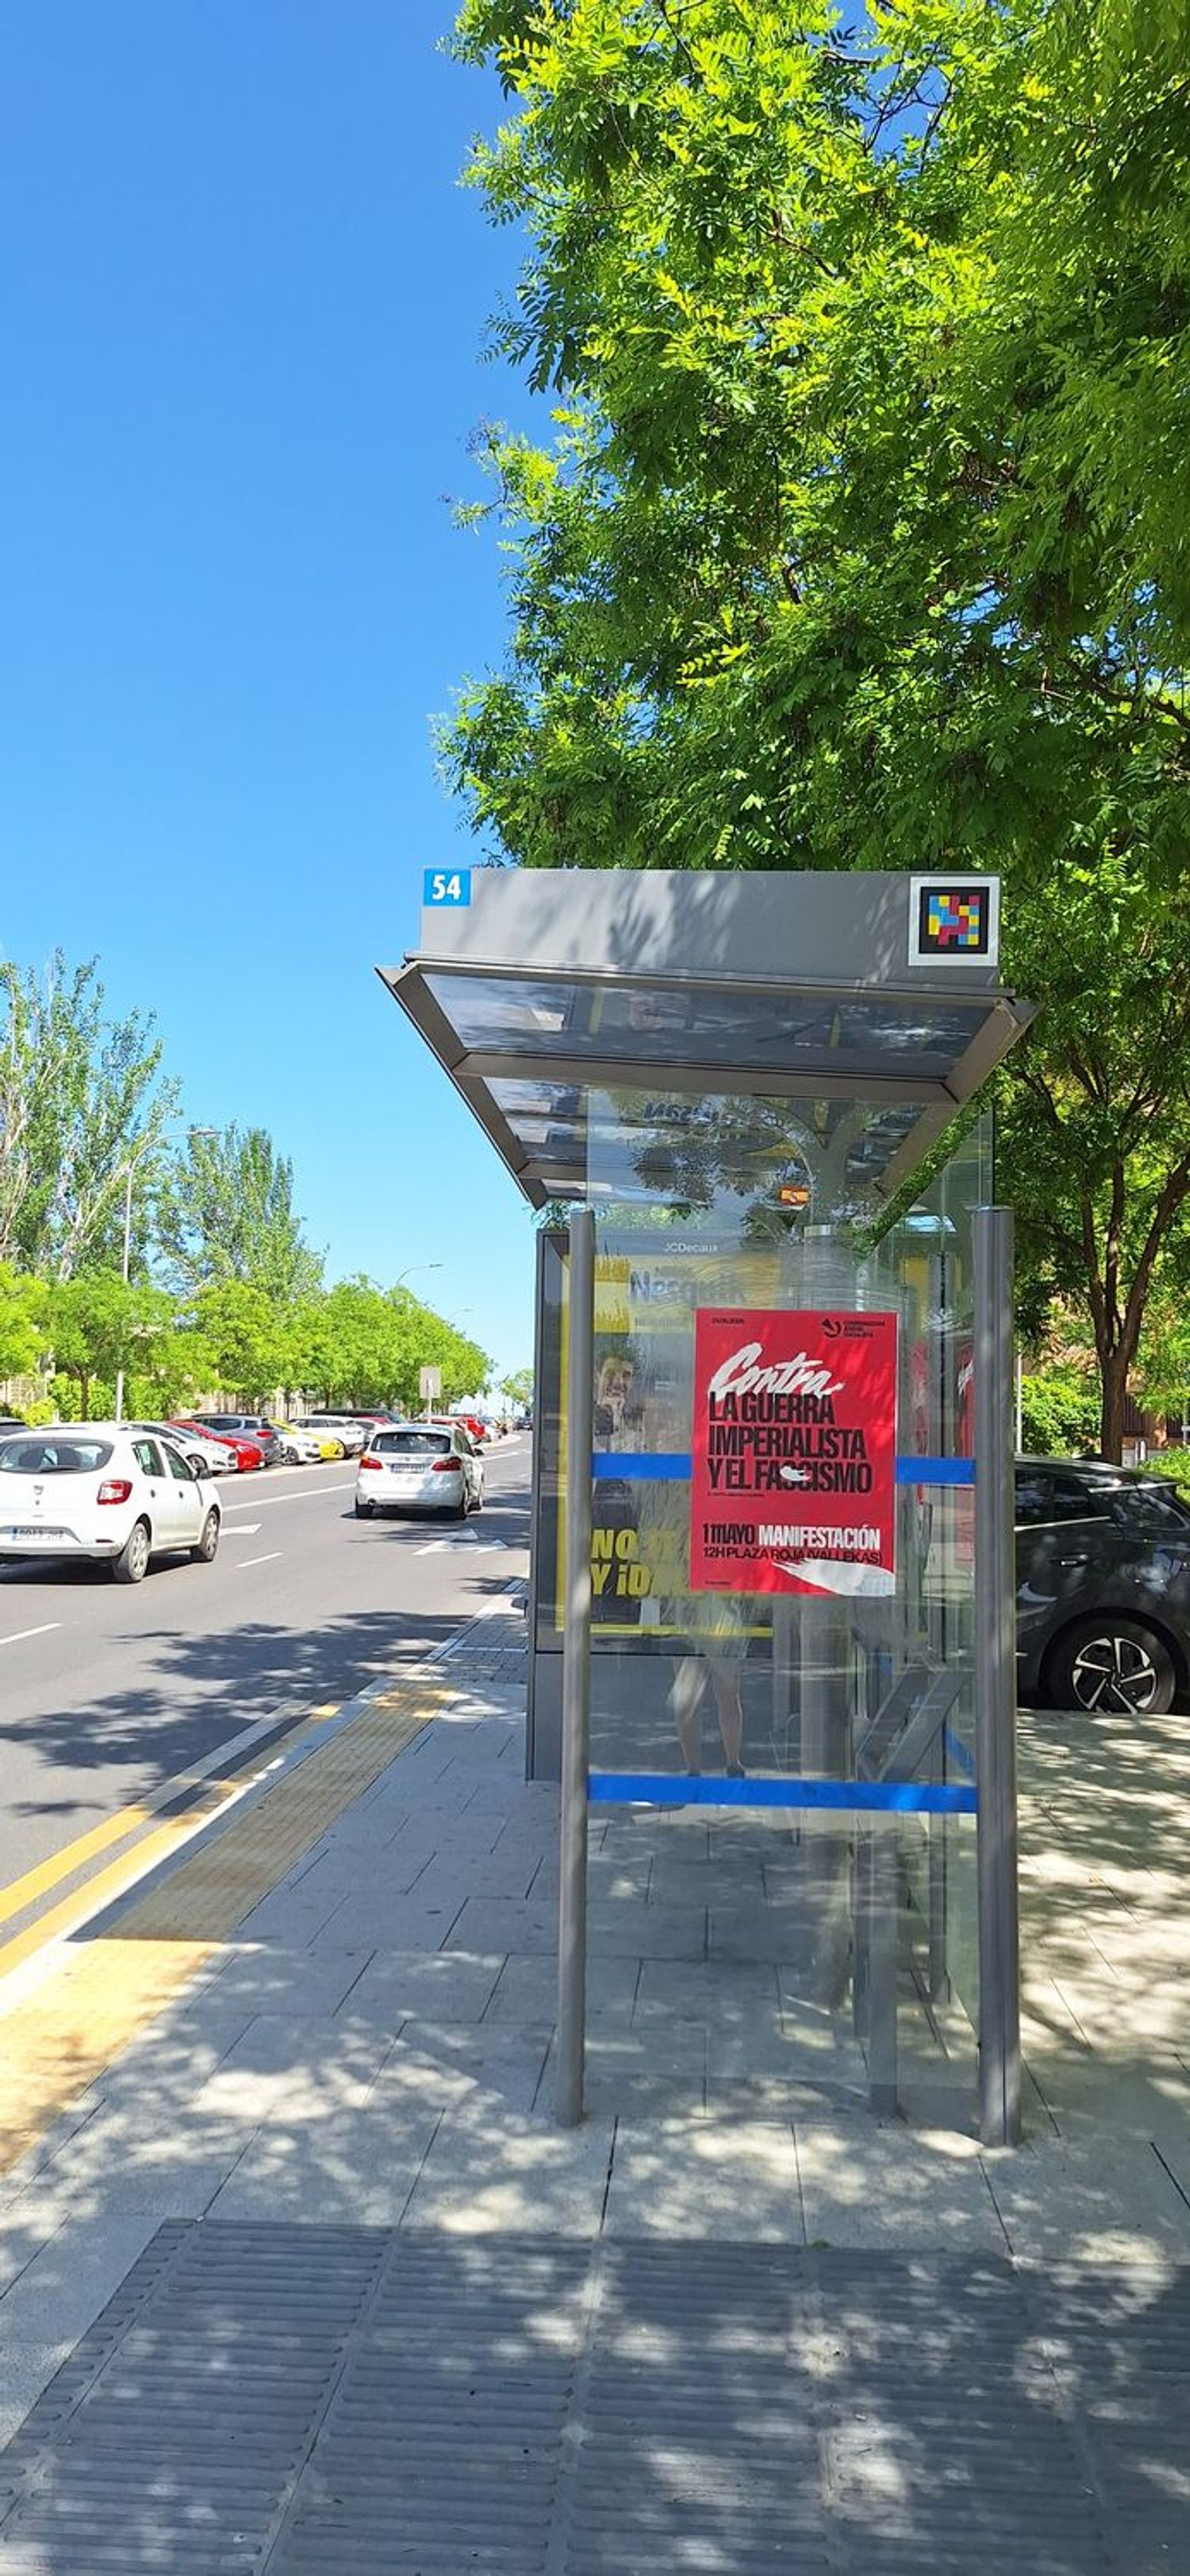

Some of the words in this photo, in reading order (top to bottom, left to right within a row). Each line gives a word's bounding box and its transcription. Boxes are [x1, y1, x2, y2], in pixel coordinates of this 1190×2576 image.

[432, 875, 461, 900] 54
[663, 1242, 717, 1253] JCDecaux
[708, 1342, 846, 1402] Contra
[709, 1391, 738, 1421] LA
[742, 1393, 835, 1424] GUERRA
[708, 1426, 866, 1459] IMPERIALISTA
[707, 1458, 724, 1488] Y
[726, 1459, 751, 1489] EL
[755, 1461, 872, 1493] FASCISMO
[591, 1528, 638, 1560] NO
[758, 1524, 880, 1550] MANIFESTACIÓN
[727, 1547, 769, 1560] PLAZA
[771, 1549, 804, 1561] ROJA
[590, 1564, 612, 1595] Y
